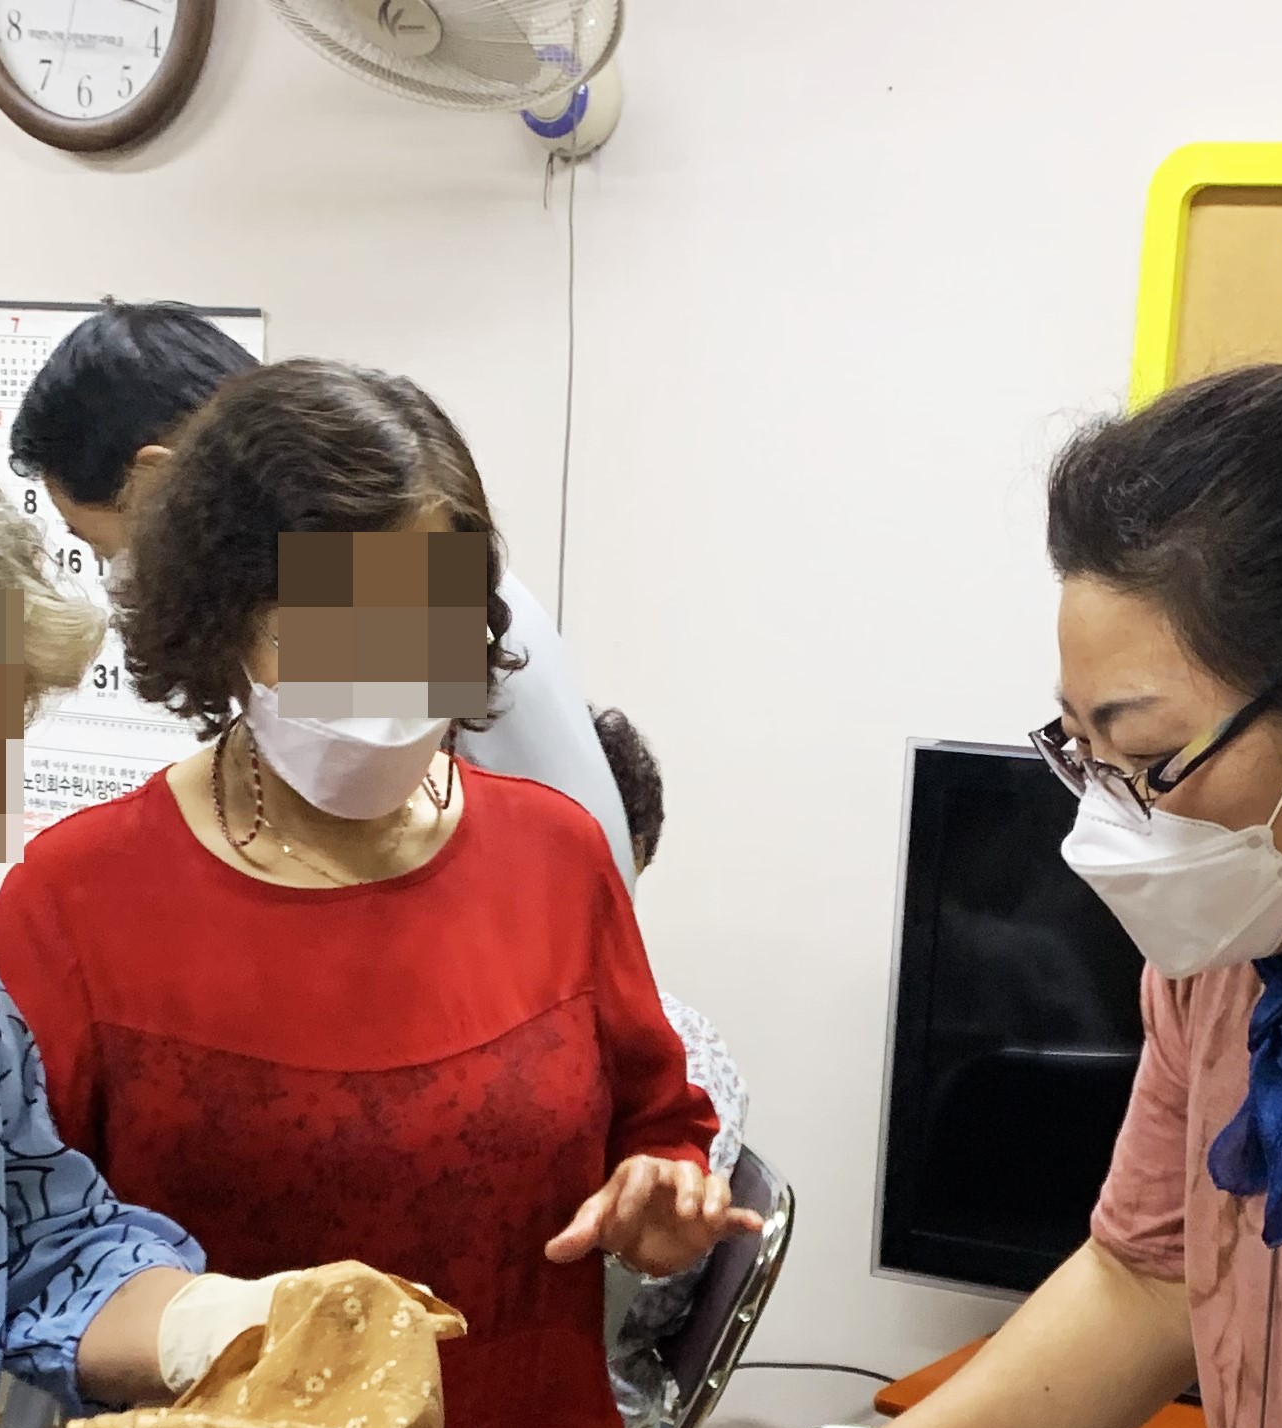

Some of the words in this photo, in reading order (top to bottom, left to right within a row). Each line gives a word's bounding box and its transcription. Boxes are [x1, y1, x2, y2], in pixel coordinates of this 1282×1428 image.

[7, 9, 22, 43] 8
[146, 25, 162, 58] 4
[39, 59, 54, 91] 7
[77, 74, 92, 108] 6
[117, 65, 133, 99] 5
[11, 317, 20, 334] 7
[23, 489, 38, 515] 8
[55, 548, 82, 574] 16
[93, 664, 120, 691] 31
